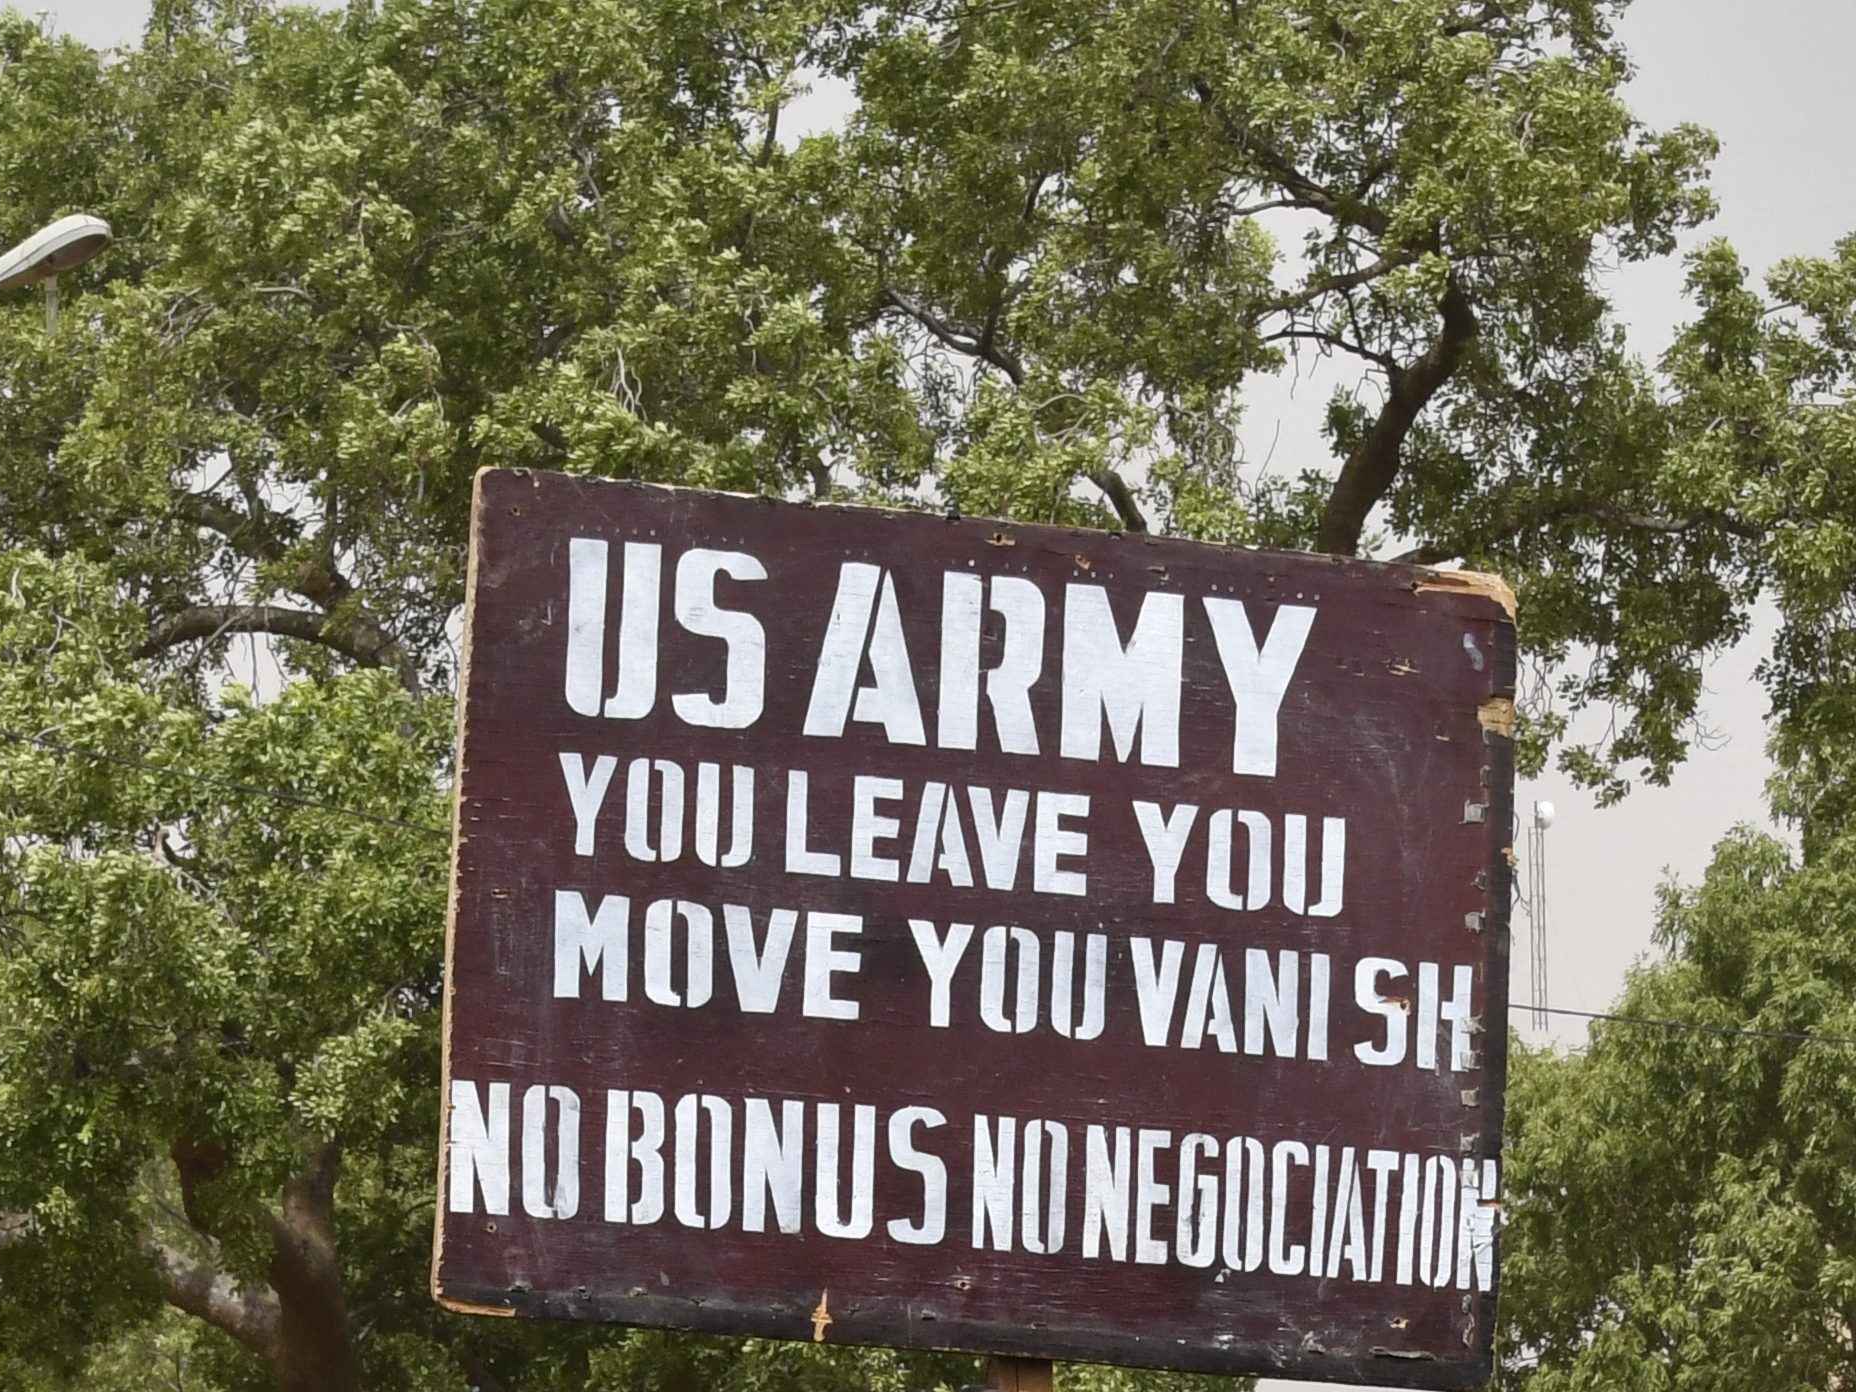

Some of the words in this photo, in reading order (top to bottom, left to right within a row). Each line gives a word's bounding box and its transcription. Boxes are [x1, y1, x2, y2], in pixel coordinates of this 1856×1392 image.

[564, 537, 768, 729] US
[802, 561, 1318, 778] ARMY
[558, 752, 755, 868] YOU
[784, 769, 1091, 897] LEAVE
[1132, 799, 1346, 918] YOU
[553, 889, 864, 1020] MOVE
[907, 918, 1108, 1041] YOU
[449, 1080, 581, 1220] NO
[604, 1088, 948, 1245] BONUS
[971, 1113, 1069, 1255] NO
[1082, 1124, 1499, 1292] NEGOCIATION
